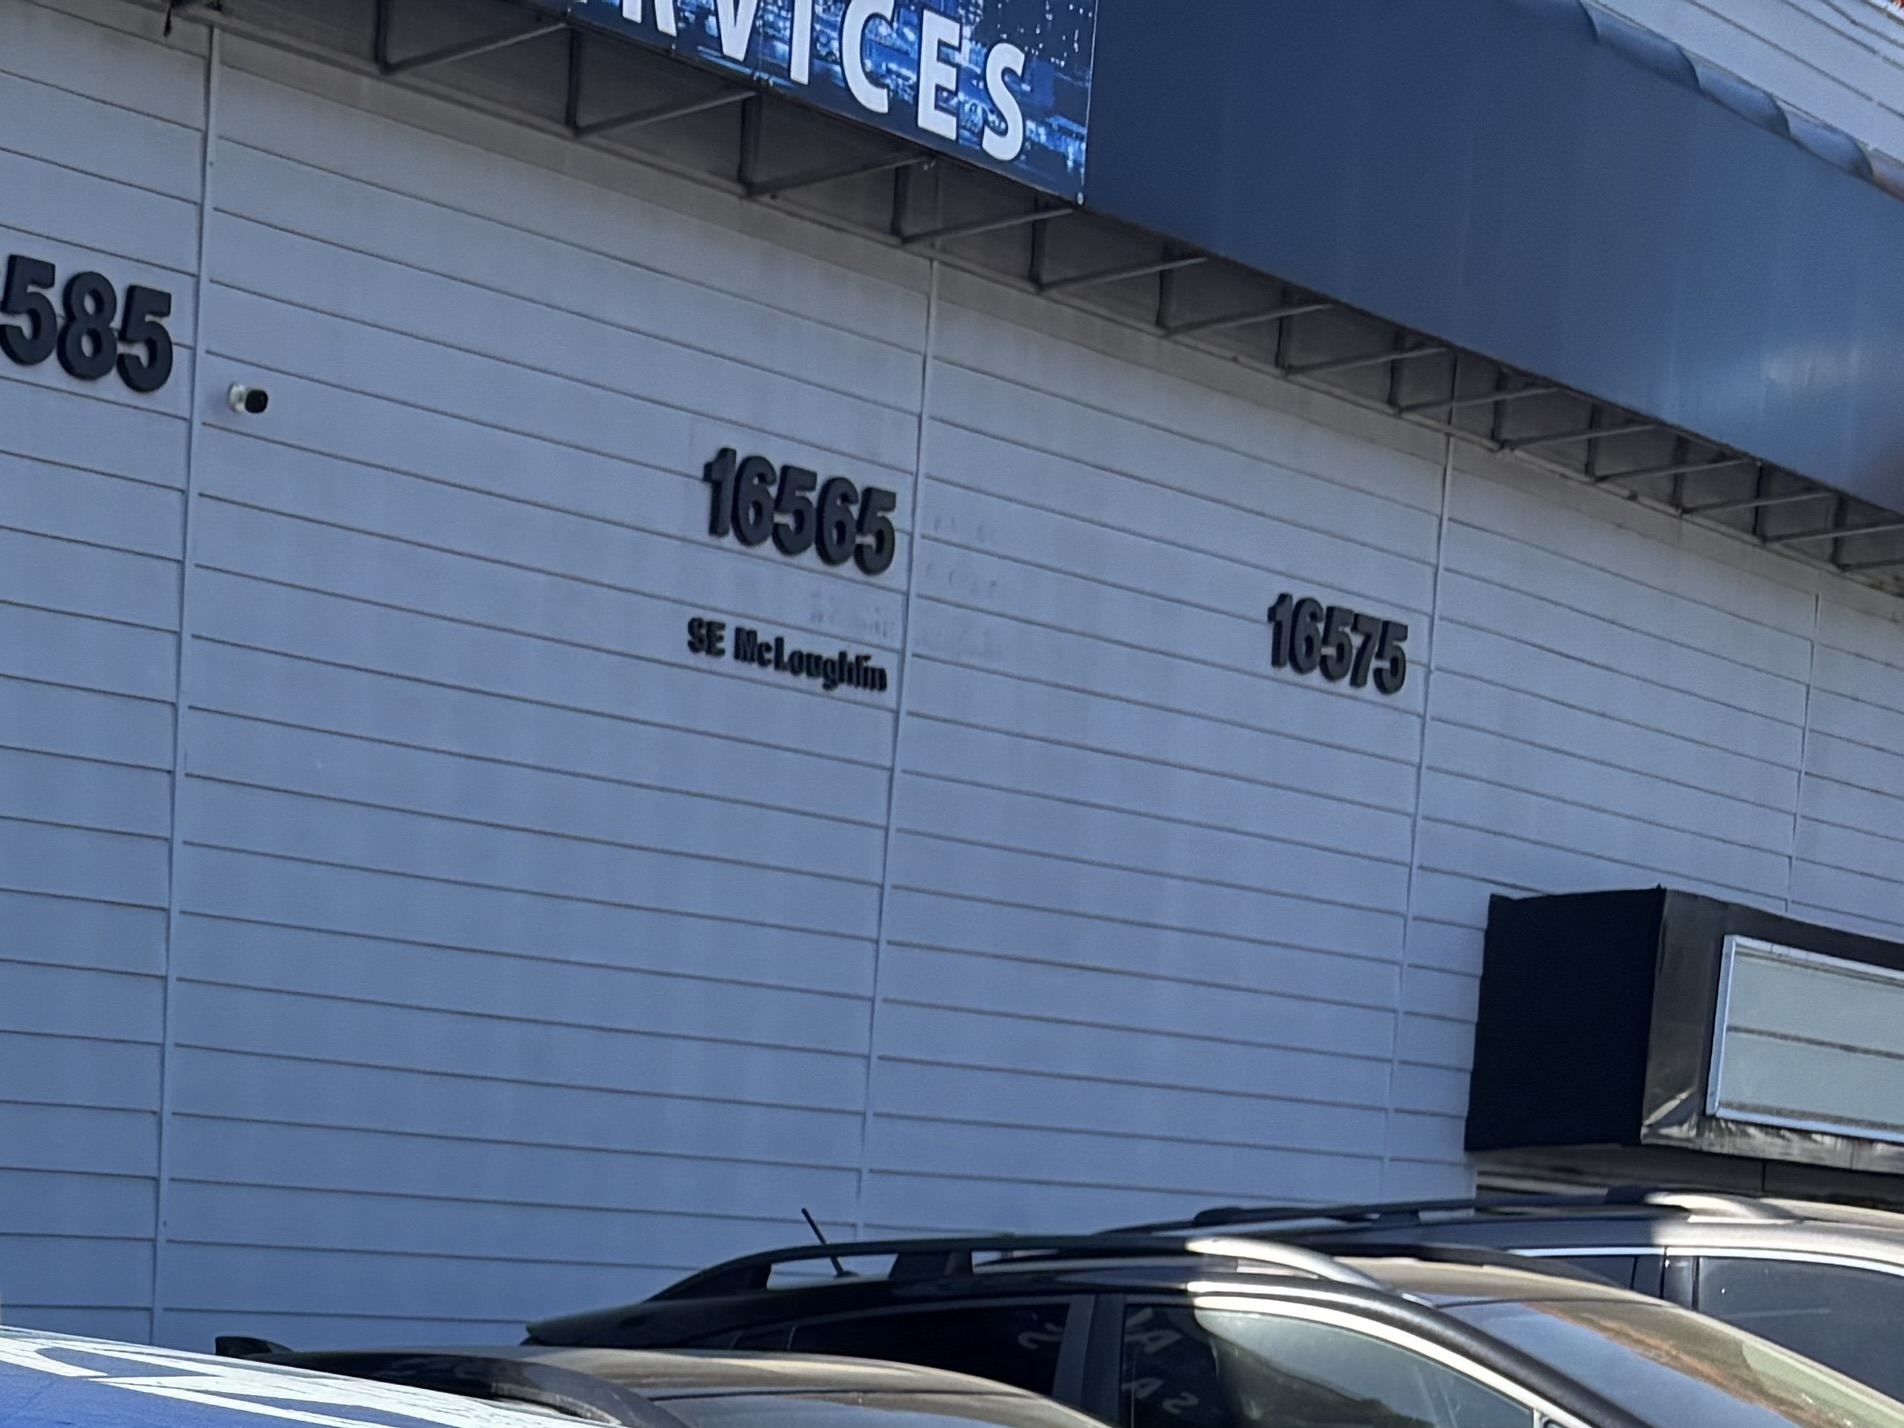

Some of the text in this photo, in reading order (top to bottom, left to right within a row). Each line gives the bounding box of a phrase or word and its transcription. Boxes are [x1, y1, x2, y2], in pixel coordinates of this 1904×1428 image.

[703, 447, 897, 576] 16565
[687, 616, 888, 693] SE McLoughlin
[1267, 592, 1409, 695] 16575
